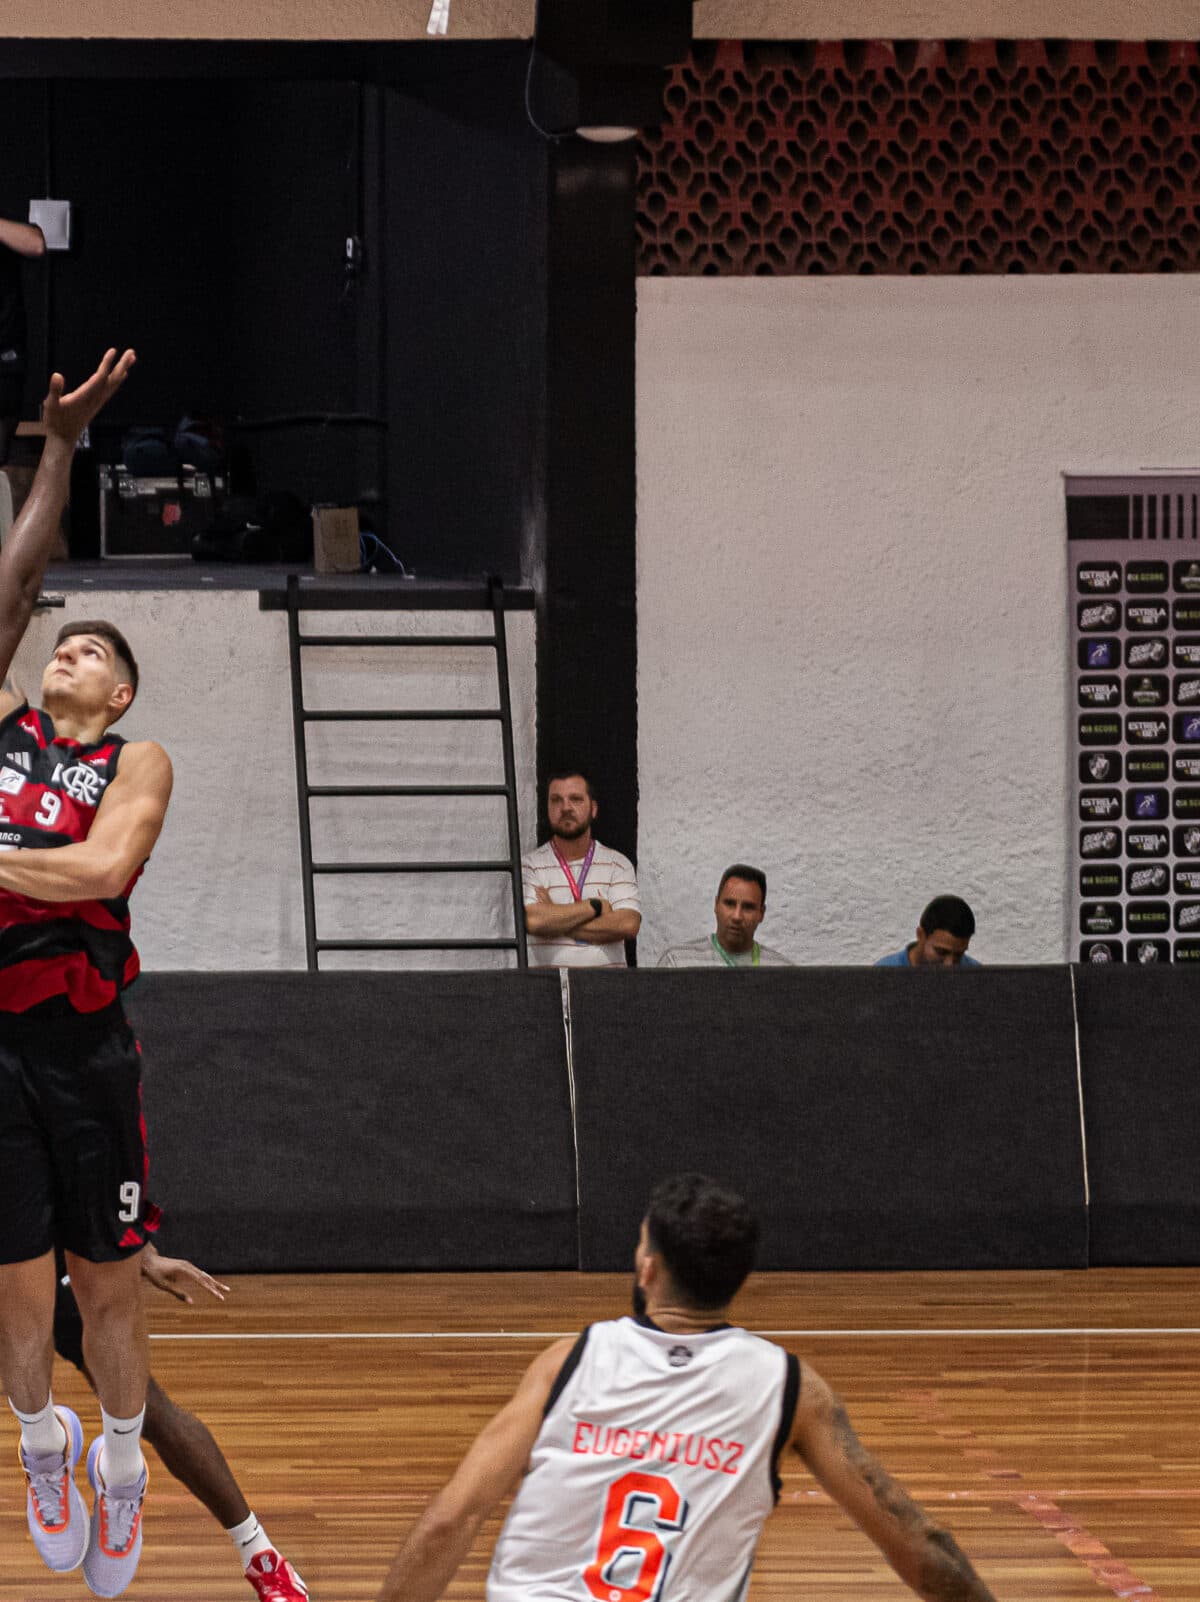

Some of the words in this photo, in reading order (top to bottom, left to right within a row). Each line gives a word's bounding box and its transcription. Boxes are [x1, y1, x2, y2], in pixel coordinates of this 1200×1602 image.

[35, 791, 62, 826] 9
[118, 1181, 141, 1222] 9
[572, 1421, 745, 1475] EUGENIUSZ
[581, 1471, 690, 1602] 6
